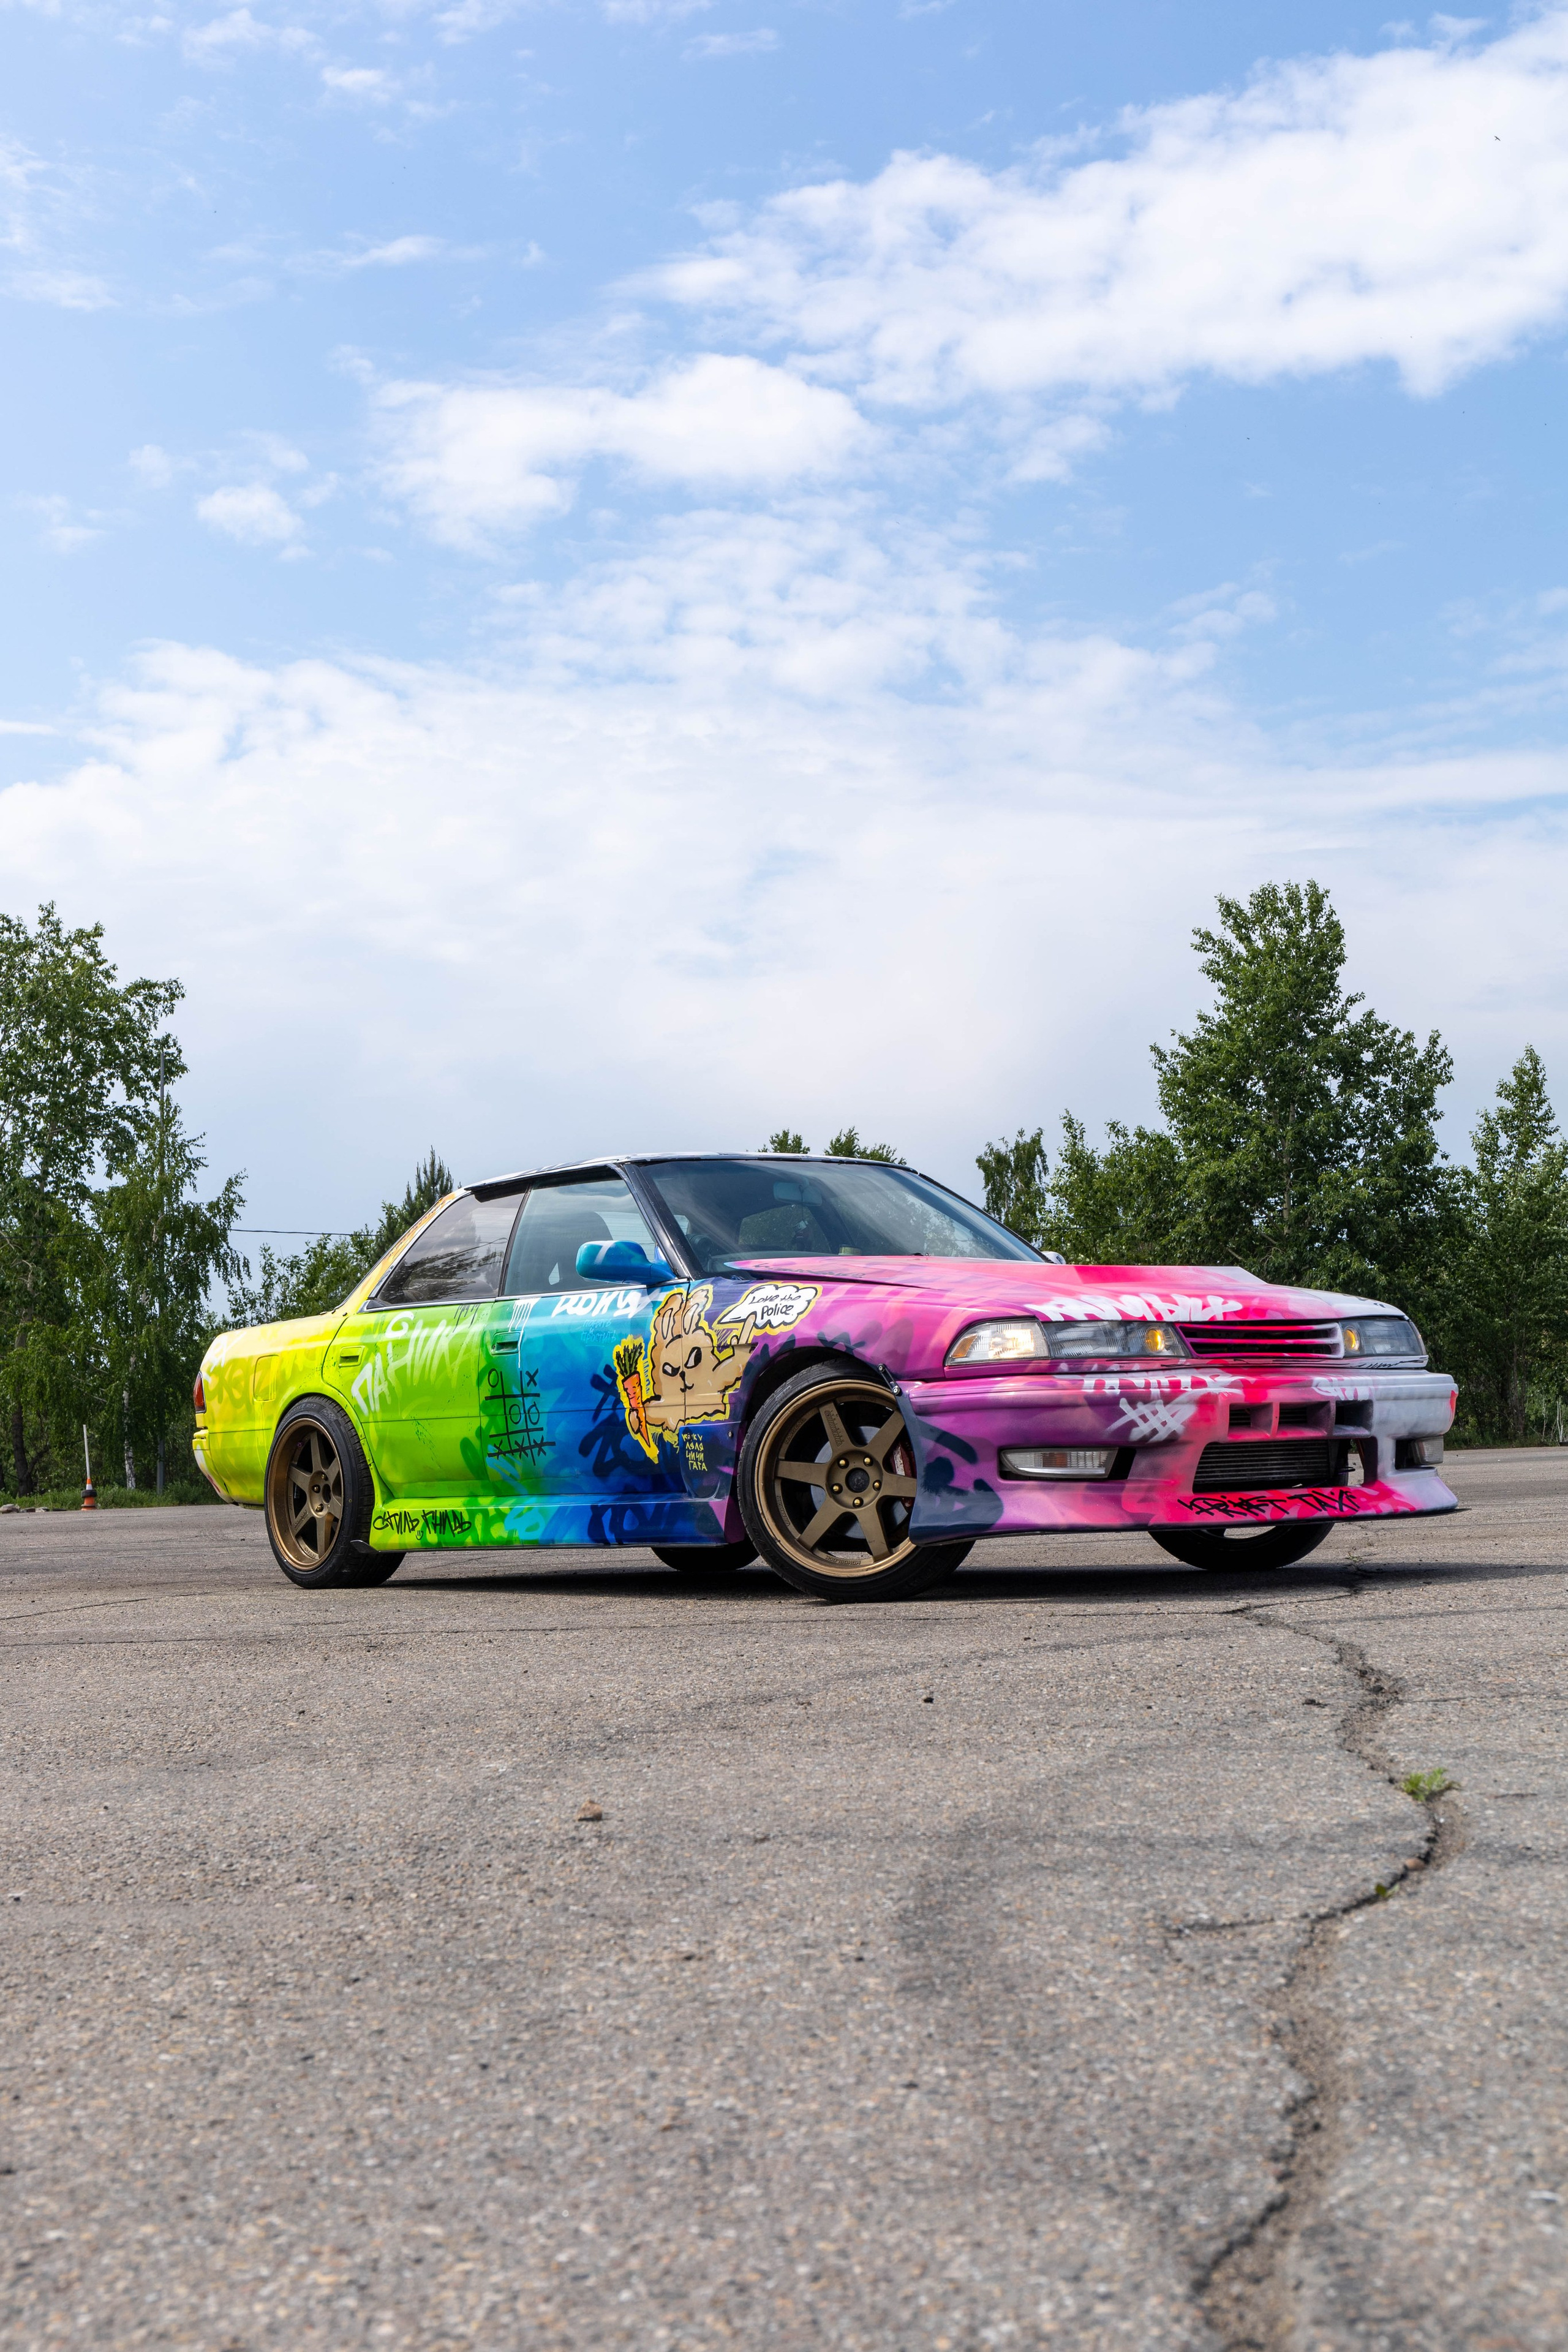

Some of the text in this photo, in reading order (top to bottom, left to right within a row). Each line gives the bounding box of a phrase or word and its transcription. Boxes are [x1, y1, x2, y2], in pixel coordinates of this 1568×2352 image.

[748, 1295, 779, 1305] Love
[686, 1450, 704, 1461] ЧИЧИ
[688, 1461, 707, 1471] ГАГА
